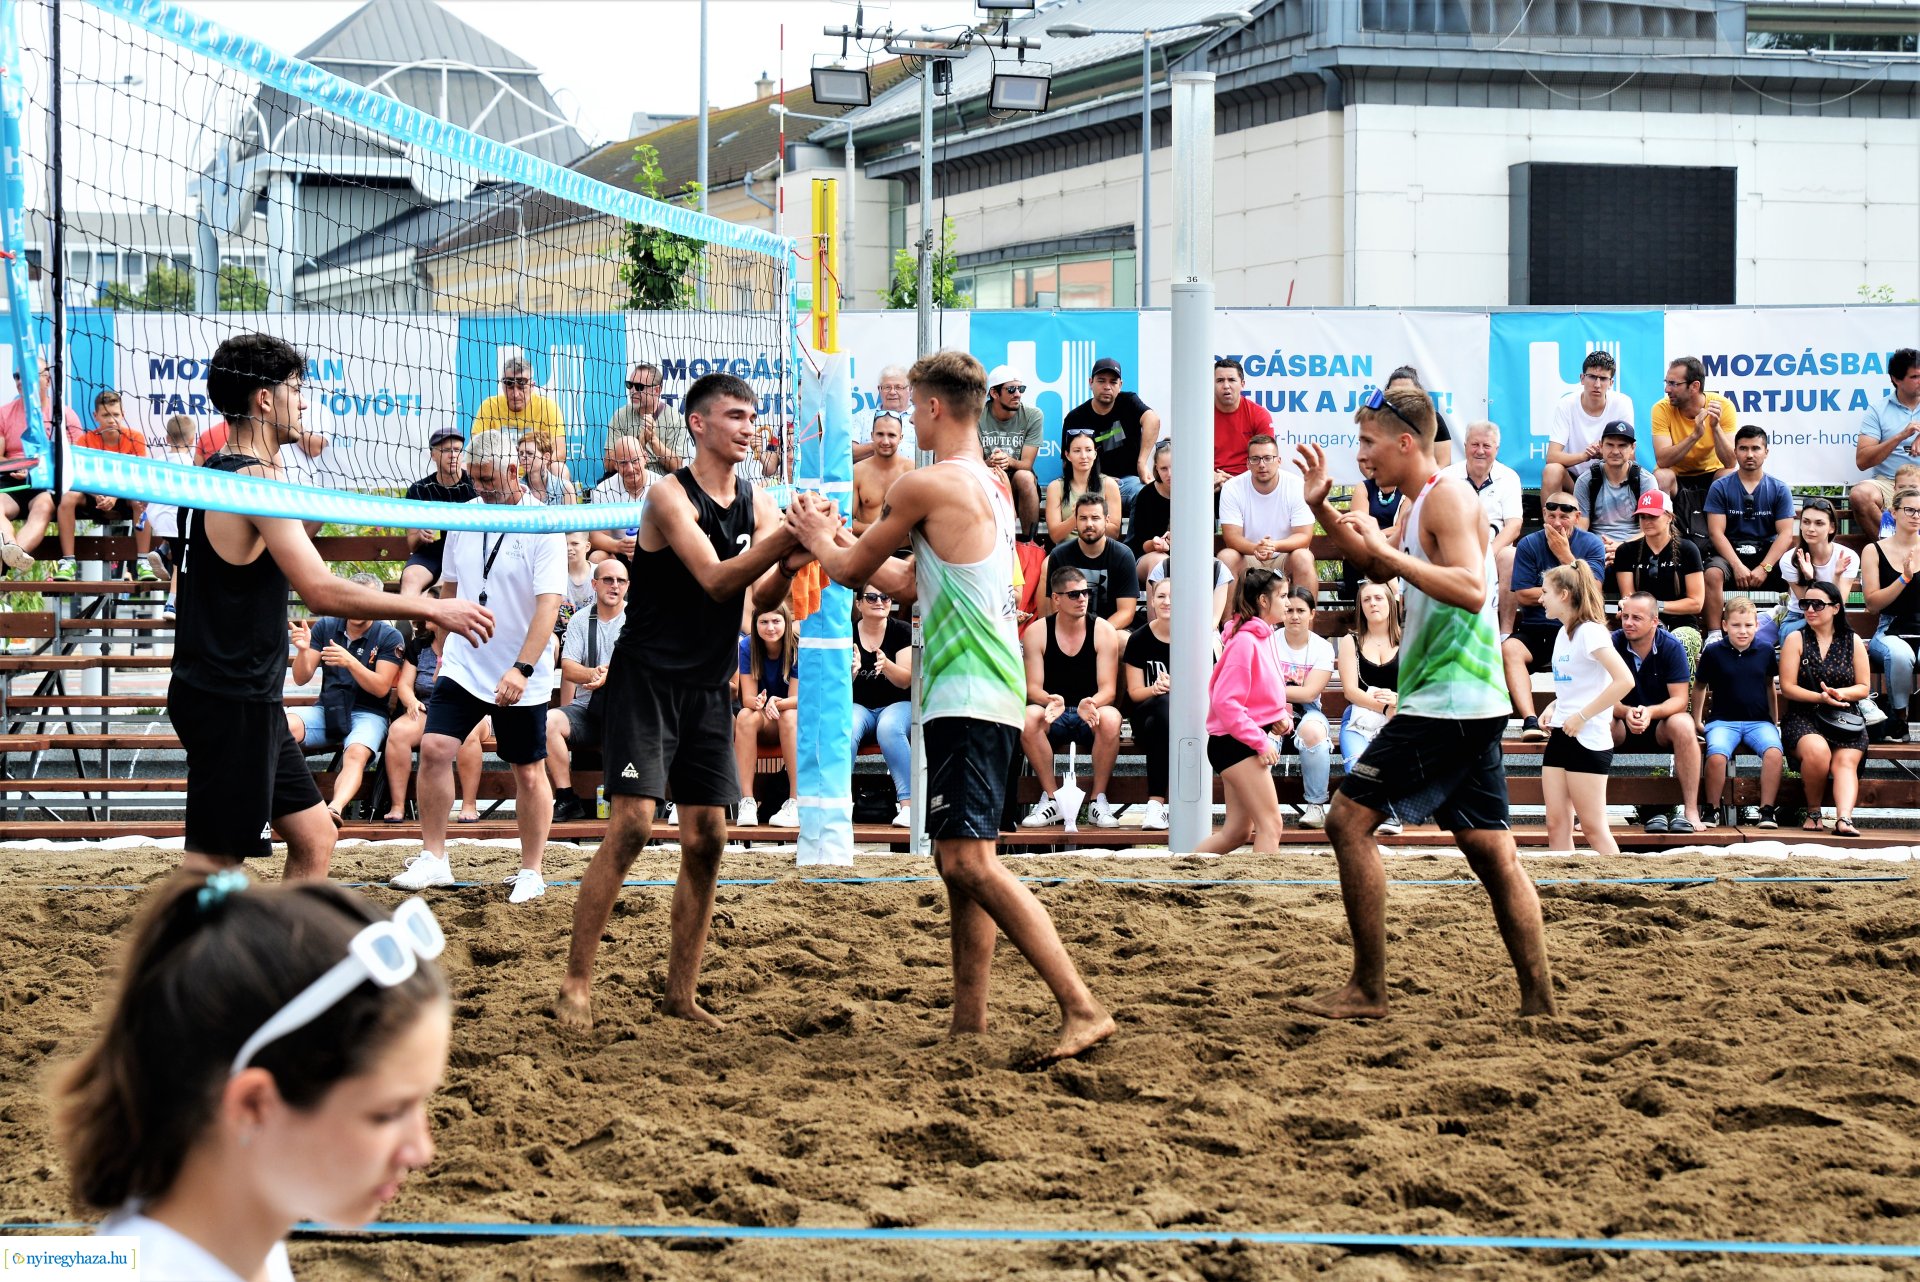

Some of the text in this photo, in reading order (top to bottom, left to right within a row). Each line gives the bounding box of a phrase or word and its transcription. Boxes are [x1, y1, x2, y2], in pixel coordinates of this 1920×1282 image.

[1315, 391, 1337, 413] A
[736, 533, 751, 555] 2
[621, 771, 640, 779] PEAK
